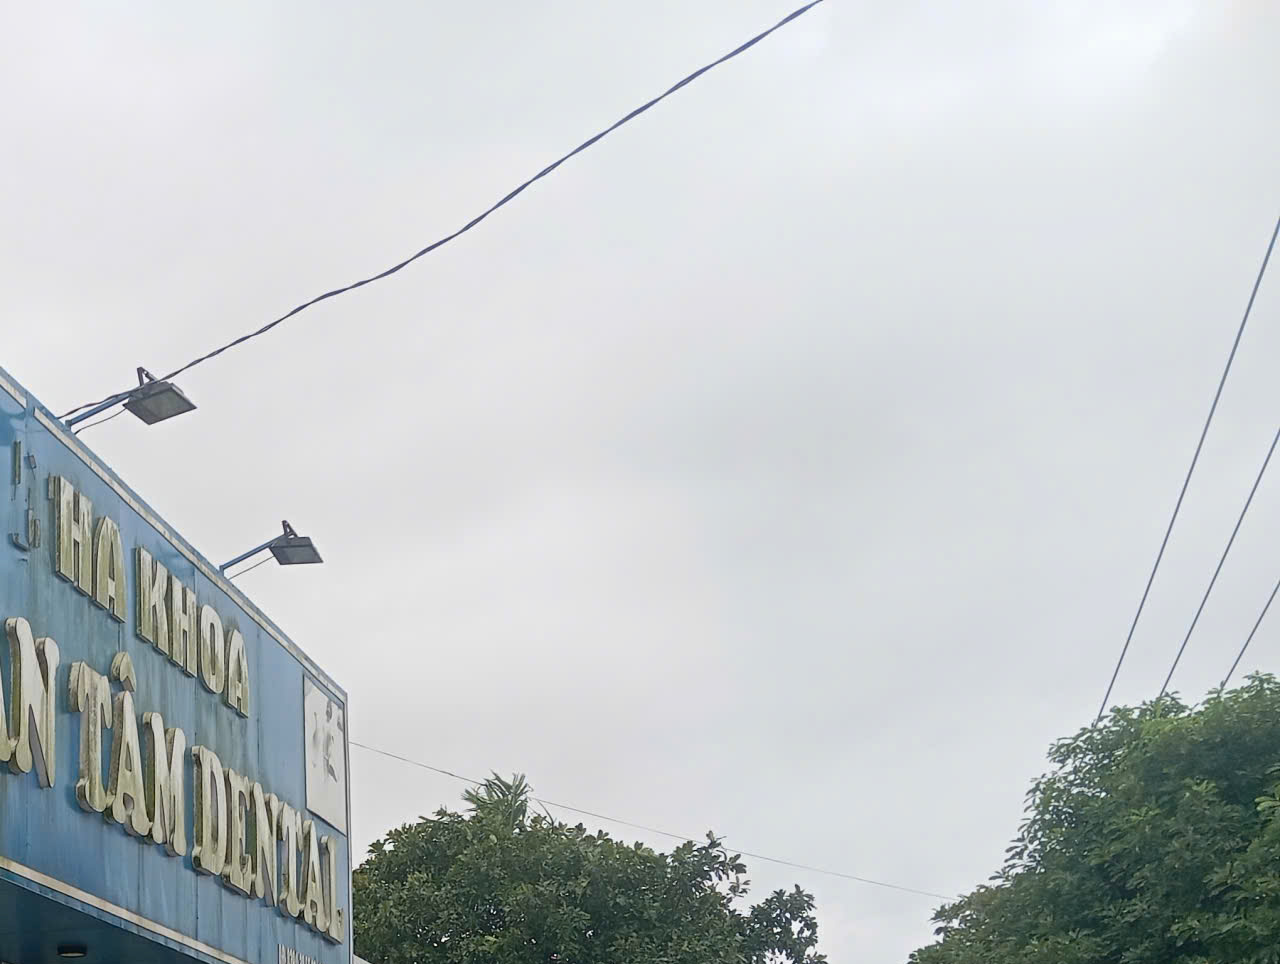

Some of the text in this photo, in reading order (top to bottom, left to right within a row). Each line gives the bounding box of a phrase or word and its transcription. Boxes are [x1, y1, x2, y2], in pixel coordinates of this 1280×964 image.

[135, 546, 250, 718] KHOA
[69, 652, 187, 857] TÂM
[191, 745, 345, 944] DENTAL
